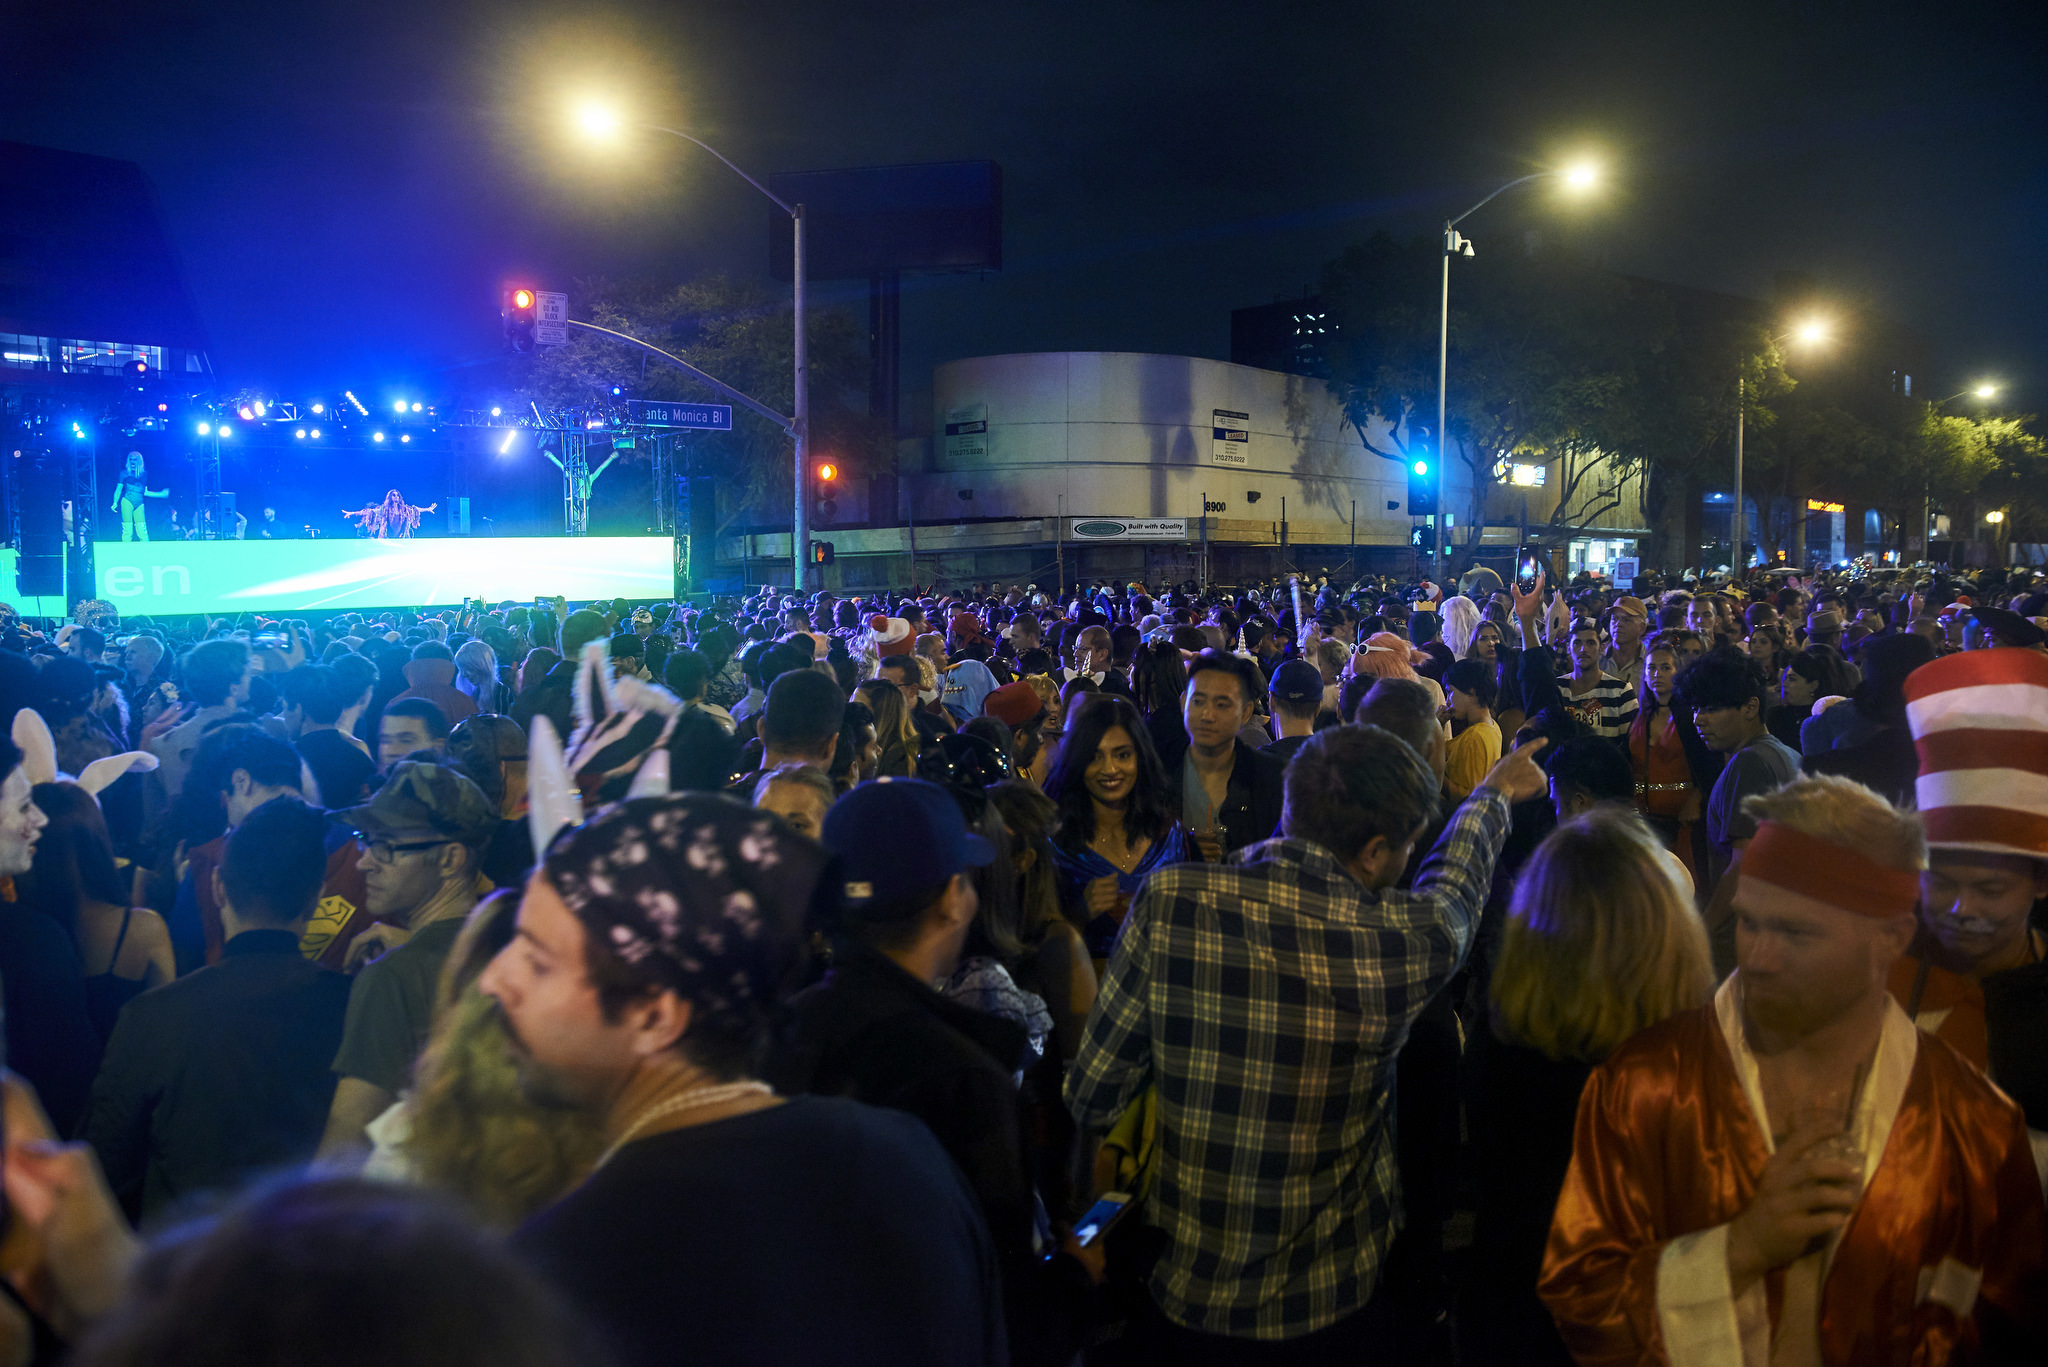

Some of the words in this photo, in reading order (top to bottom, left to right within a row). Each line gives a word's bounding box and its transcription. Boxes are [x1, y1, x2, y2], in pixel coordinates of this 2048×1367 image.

[545, 312, 558, 320] BLOCK
[538, 320, 565, 328] INTERSECTION
[638, 407, 668, 421] anta
[673, 409, 708, 423] Monica
[713, 411, 722, 423] Bl
[1205, 501, 1226, 513] 8900
[1160, 523, 1183, 531] Quality
